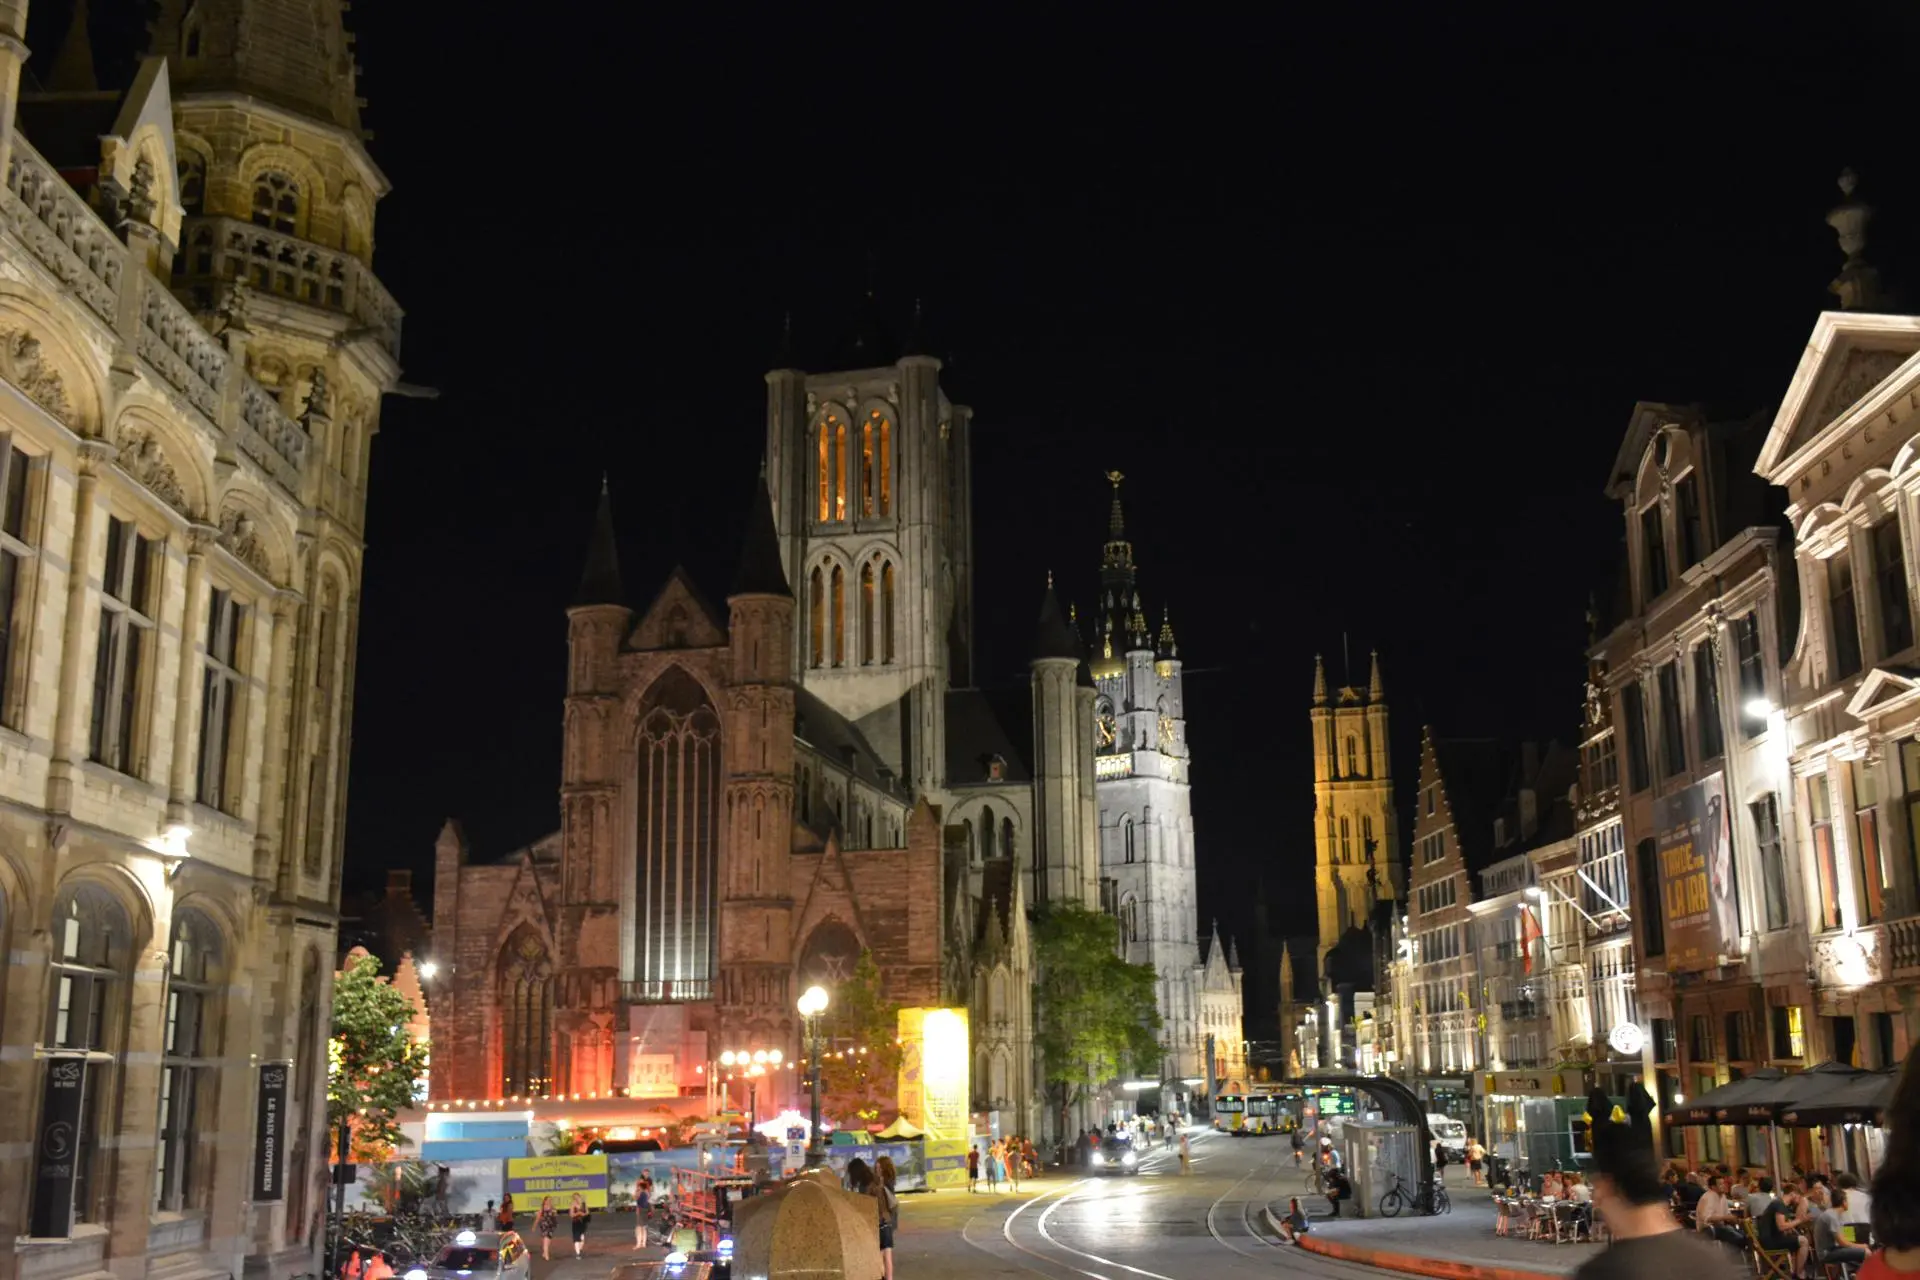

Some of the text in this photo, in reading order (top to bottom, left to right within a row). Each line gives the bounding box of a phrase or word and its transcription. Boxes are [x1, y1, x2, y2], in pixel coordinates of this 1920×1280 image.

[263, 1097, 277, 1192] LE PAIN QUOTIDIEN
